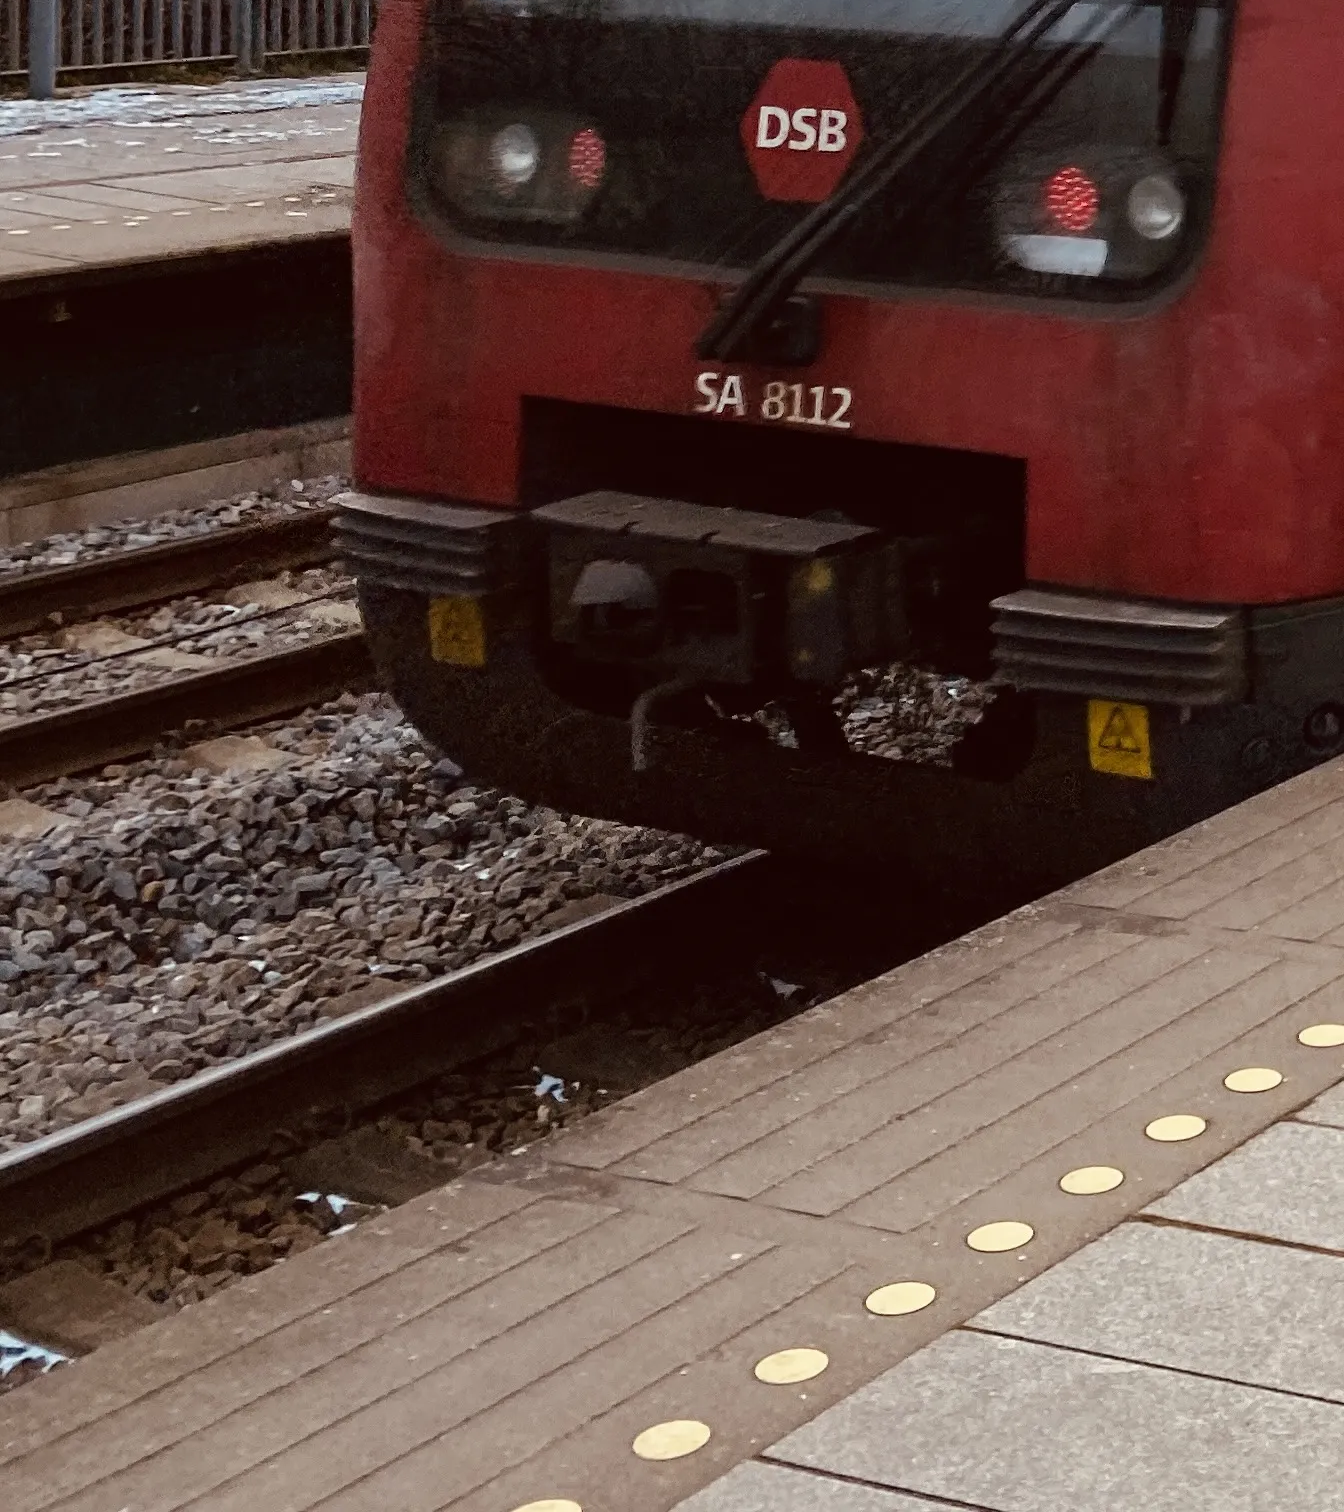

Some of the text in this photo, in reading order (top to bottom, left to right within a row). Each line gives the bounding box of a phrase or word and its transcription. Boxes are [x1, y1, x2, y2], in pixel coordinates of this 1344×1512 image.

[756, 105, 848, 152] DSB
[694, 372, 852, 429] SA 8112
